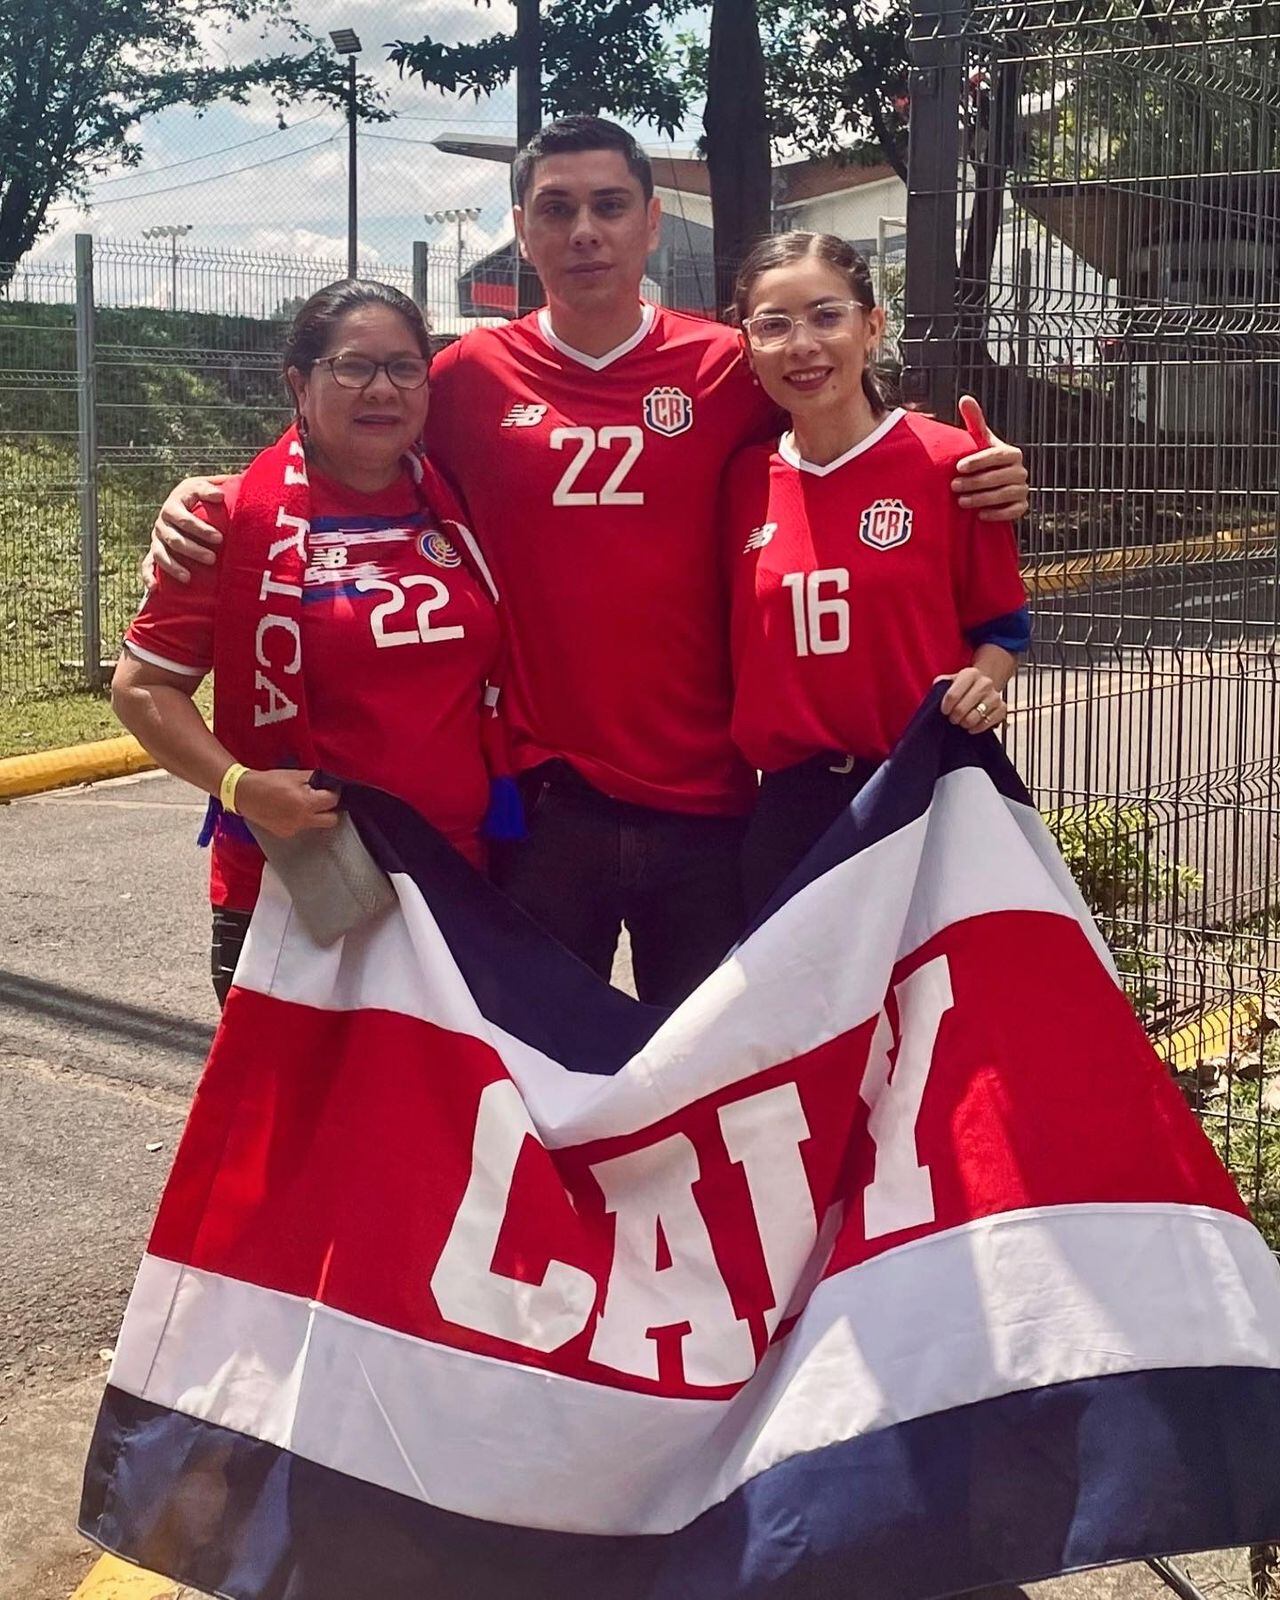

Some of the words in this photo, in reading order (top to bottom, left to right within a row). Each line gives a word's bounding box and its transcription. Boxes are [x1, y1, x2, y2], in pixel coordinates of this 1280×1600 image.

[654, 397, 682, 428] CR
[550, 425, 644, 506] 22
[872, 510, 901, 541] CR
[355, 574, 465, 649] 22
[781, 567, 850, 657] 16
